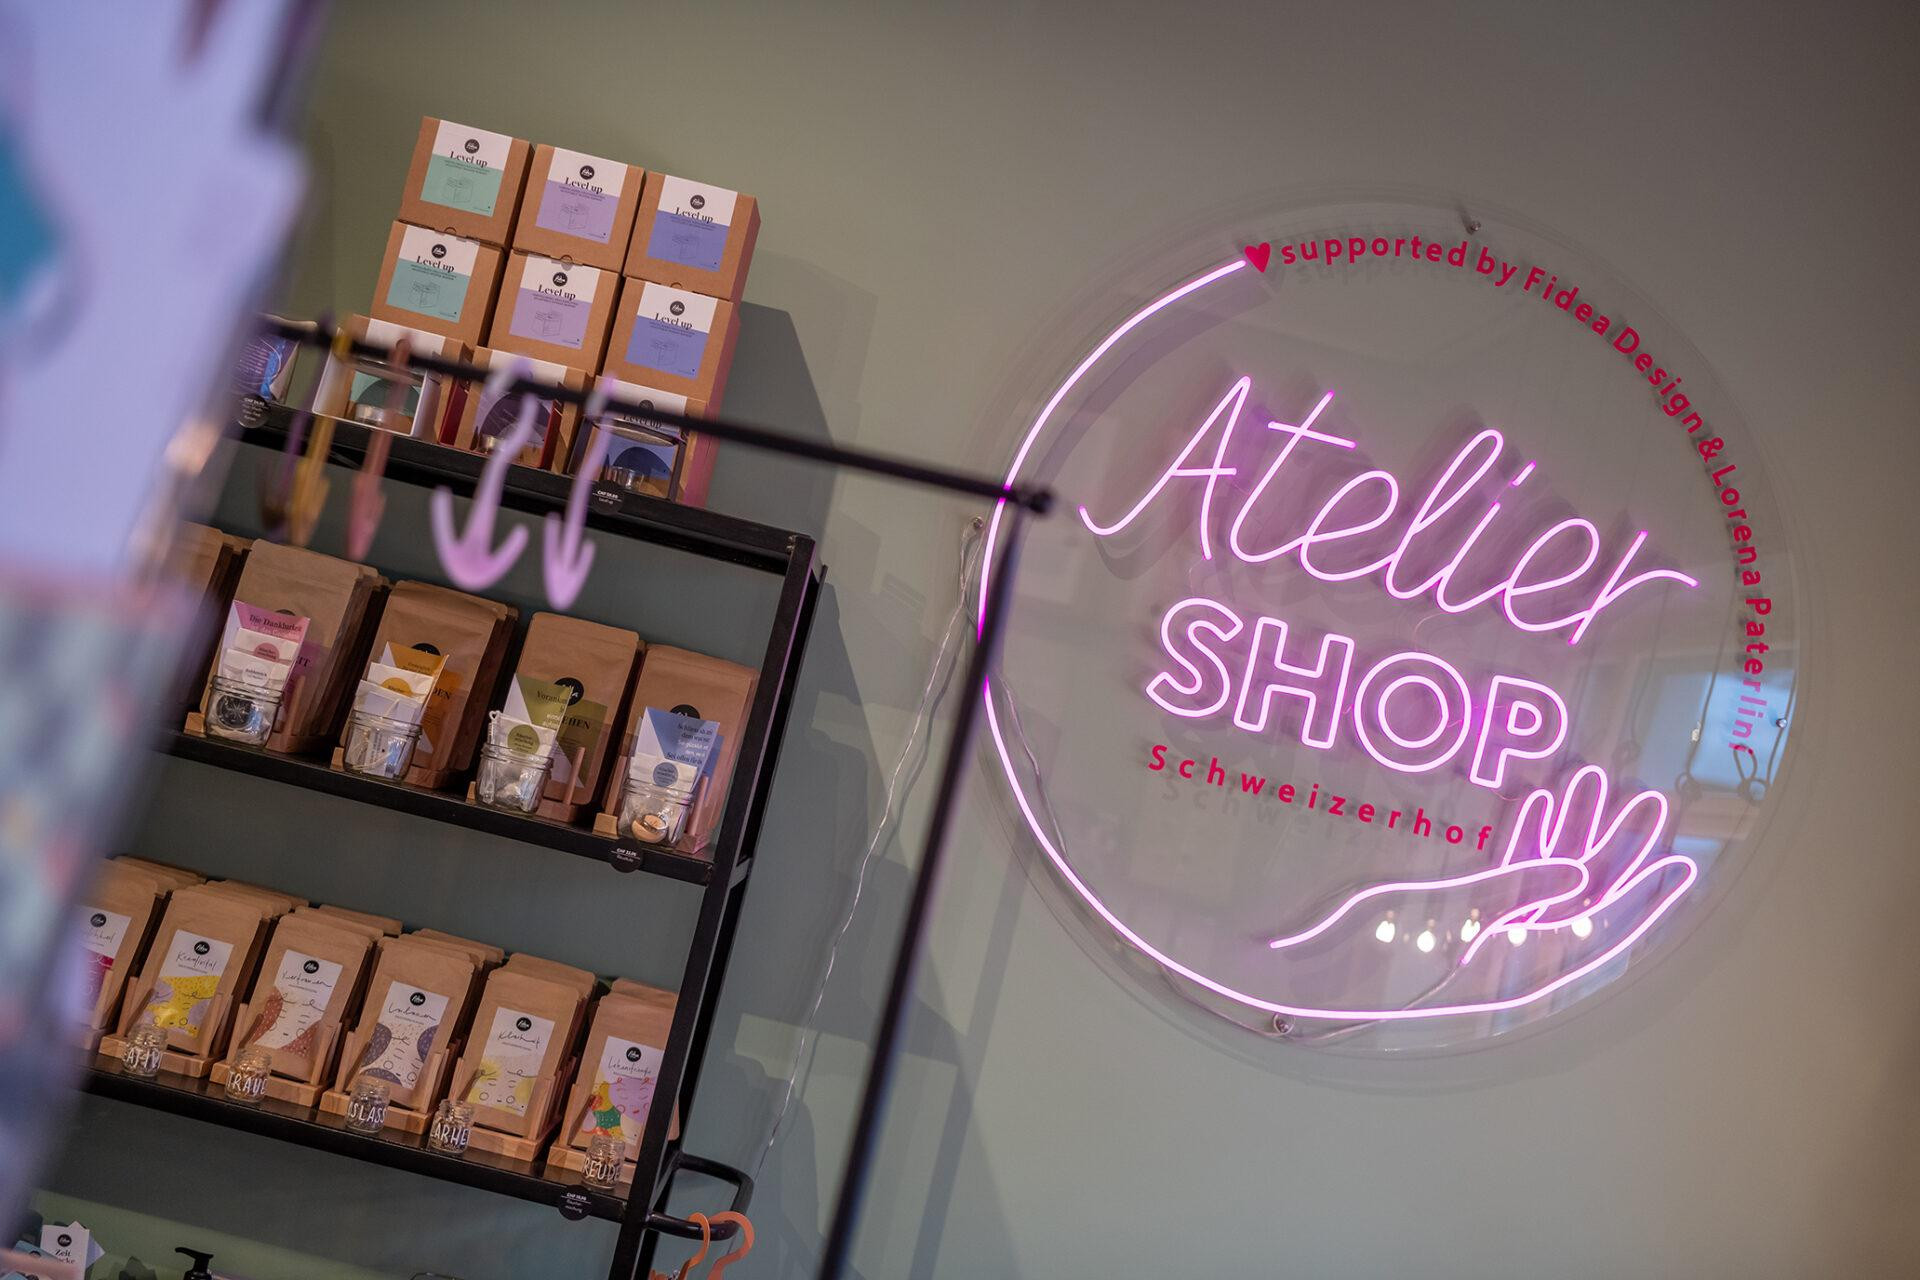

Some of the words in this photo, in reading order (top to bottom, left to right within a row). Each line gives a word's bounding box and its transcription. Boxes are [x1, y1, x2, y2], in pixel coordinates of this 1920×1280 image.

[450, 151, 475, 164] Level
[476, 159, 488, 169] up
[564, 177, 590, 189] Level
[591, 186, 603, 195] up
[674, 207, 700, 220] Level
[701, 215, 714, 225] up
[416, 255, 441, 268] Level
[442, 264, 455, 273] up
[1281, 236, 1468, 267] supported
[1476, 247, 1518, 287] by
[537, 284, 563, 296] Level
[564, 292, 576, 302] up
[1524, 266, 1611, 336] Fidea
[654, 312, 680, 326] Level
[680, 321, 693, 331] up
[1613, 327, 1703, 433] Design
[1698, 437, 1724, 463] &
[1080, 376, 1699, 645] Atelier
[1712, 465, 1760, 586] Lorena
[1146, 597, 1568, 789] SHOP
[1729, 598, 1772, 755] Paterlini
[1148, 745, 1493, 851] Schweizerhof
